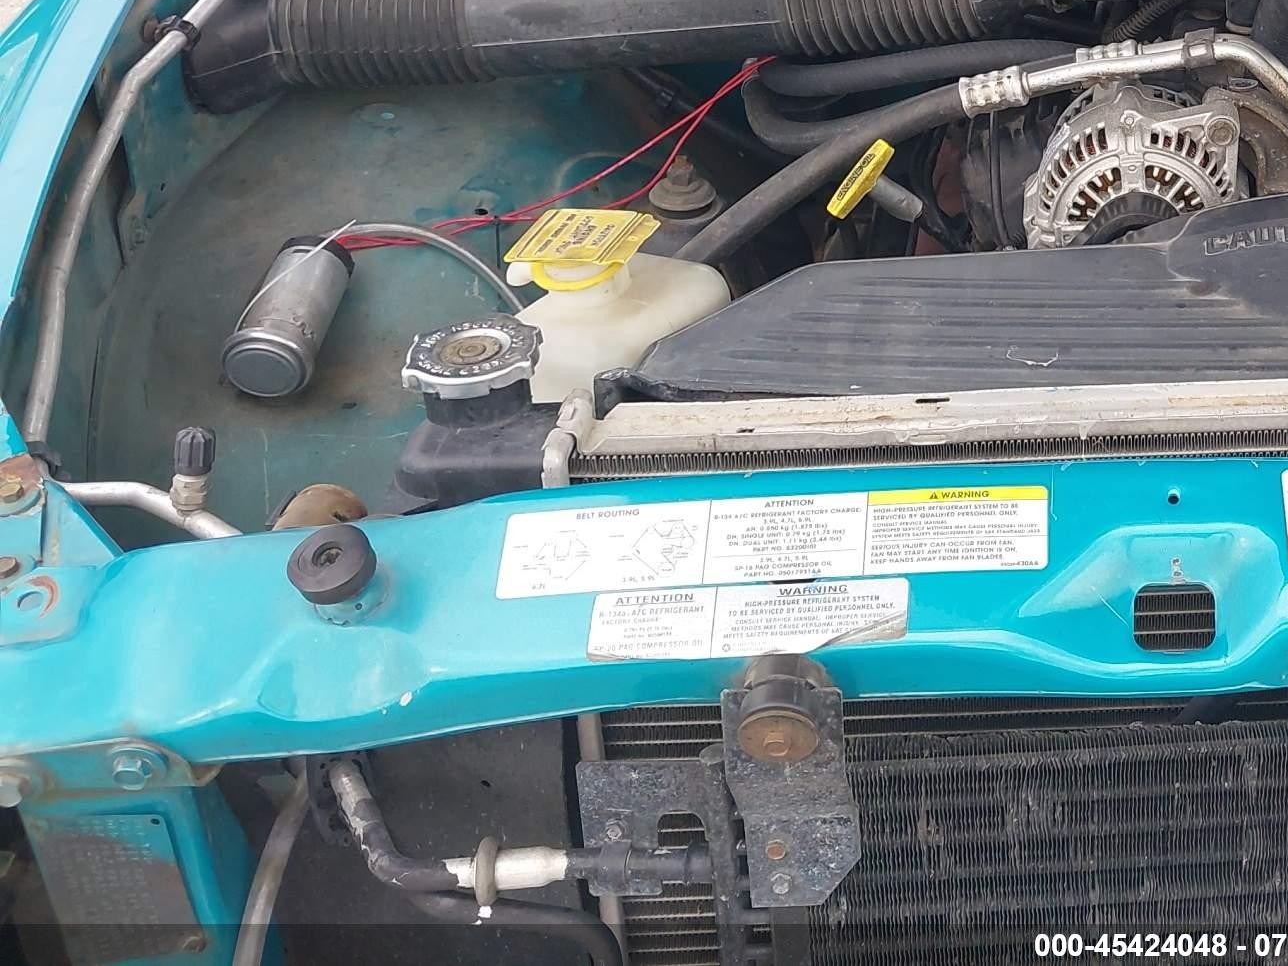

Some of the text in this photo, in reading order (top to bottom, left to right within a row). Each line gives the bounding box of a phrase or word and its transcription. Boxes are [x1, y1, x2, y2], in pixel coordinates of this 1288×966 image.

[942, 490, 988, 499] WARNING
[764, 499, 814, 507] ATTENTION
[597, 509, 639, 518] ROUTING
[779, 585, 847, 595] WARNING
[616, 593, 694, 604] ATTENTION
